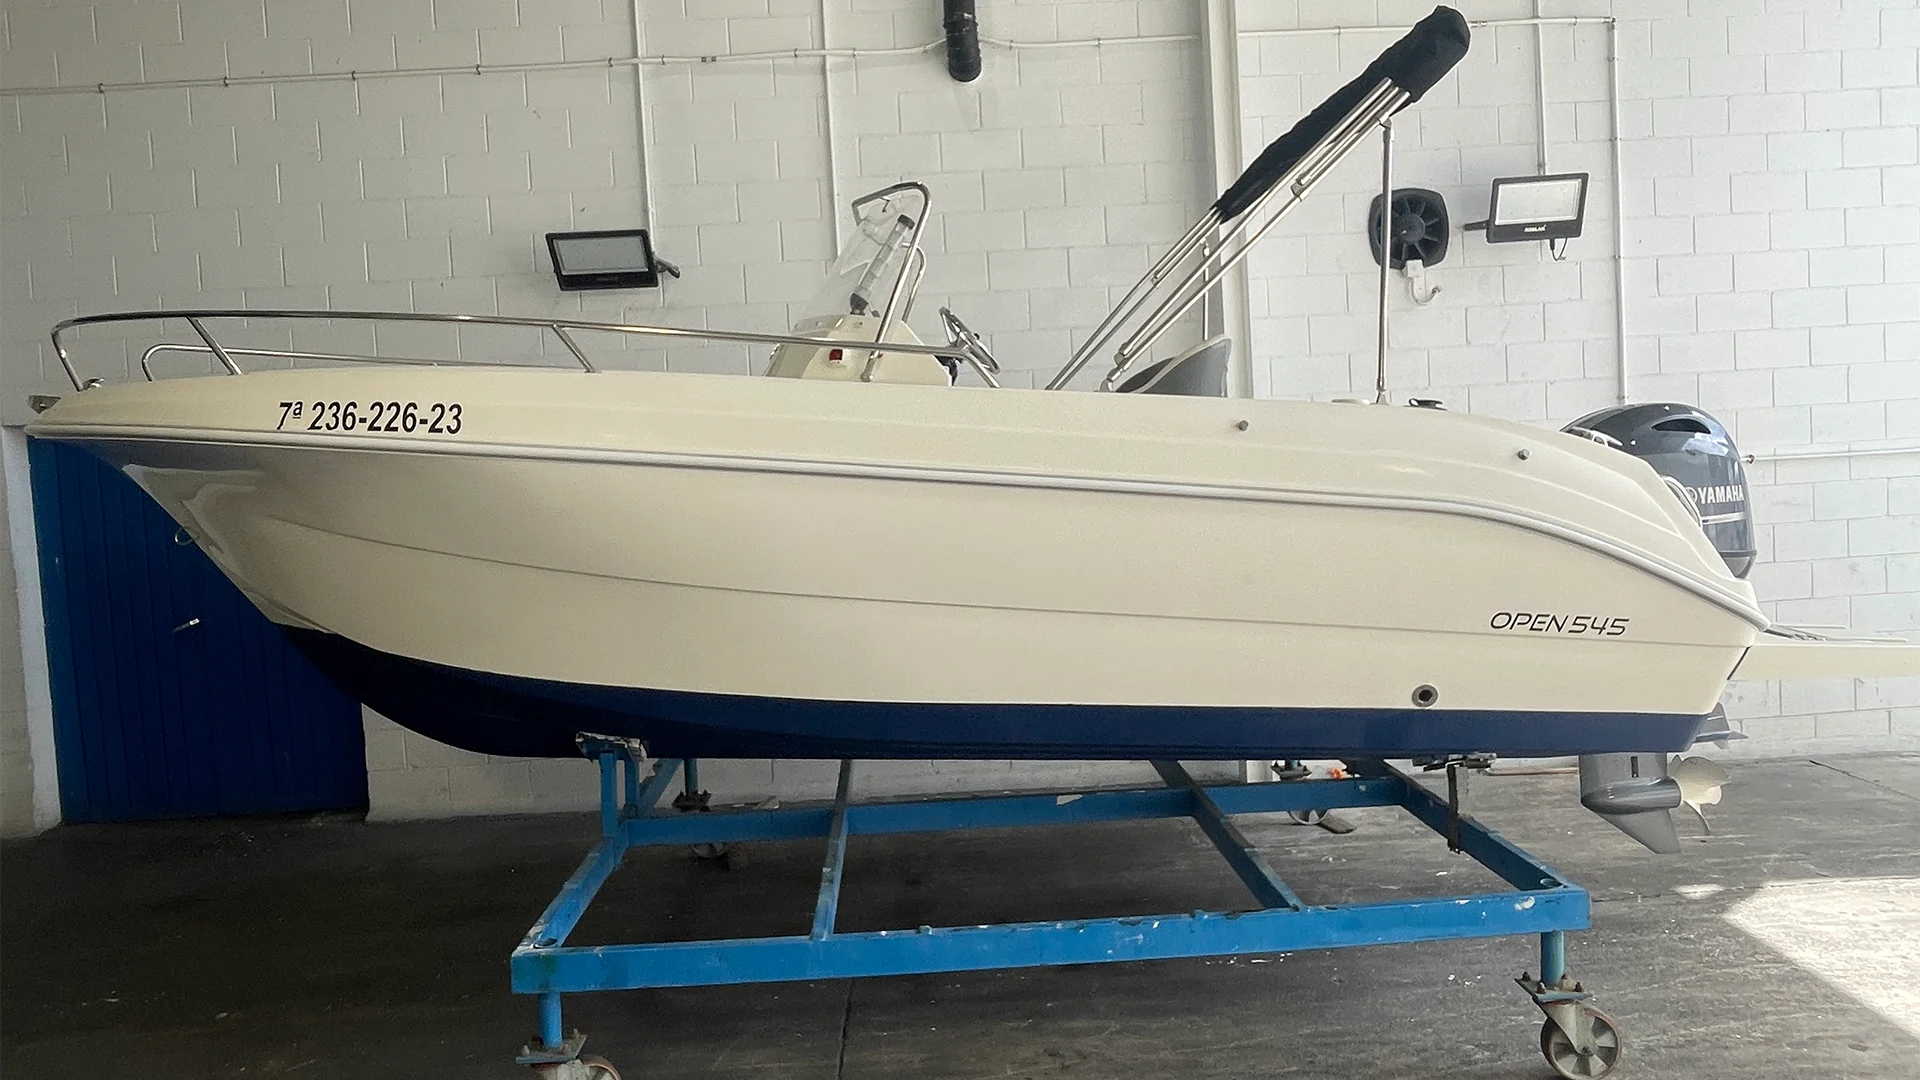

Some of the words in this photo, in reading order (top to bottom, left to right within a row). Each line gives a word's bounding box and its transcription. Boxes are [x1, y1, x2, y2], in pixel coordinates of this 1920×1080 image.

[277, 401, 303, 430] 7ª
[307, 401, 462, 434] 236-226-23
[1698, 485, 1744, 504] YAMAHA
[1490, 612, 1568, 632] OPEN
[1568, 615, 1629, 635] 545
